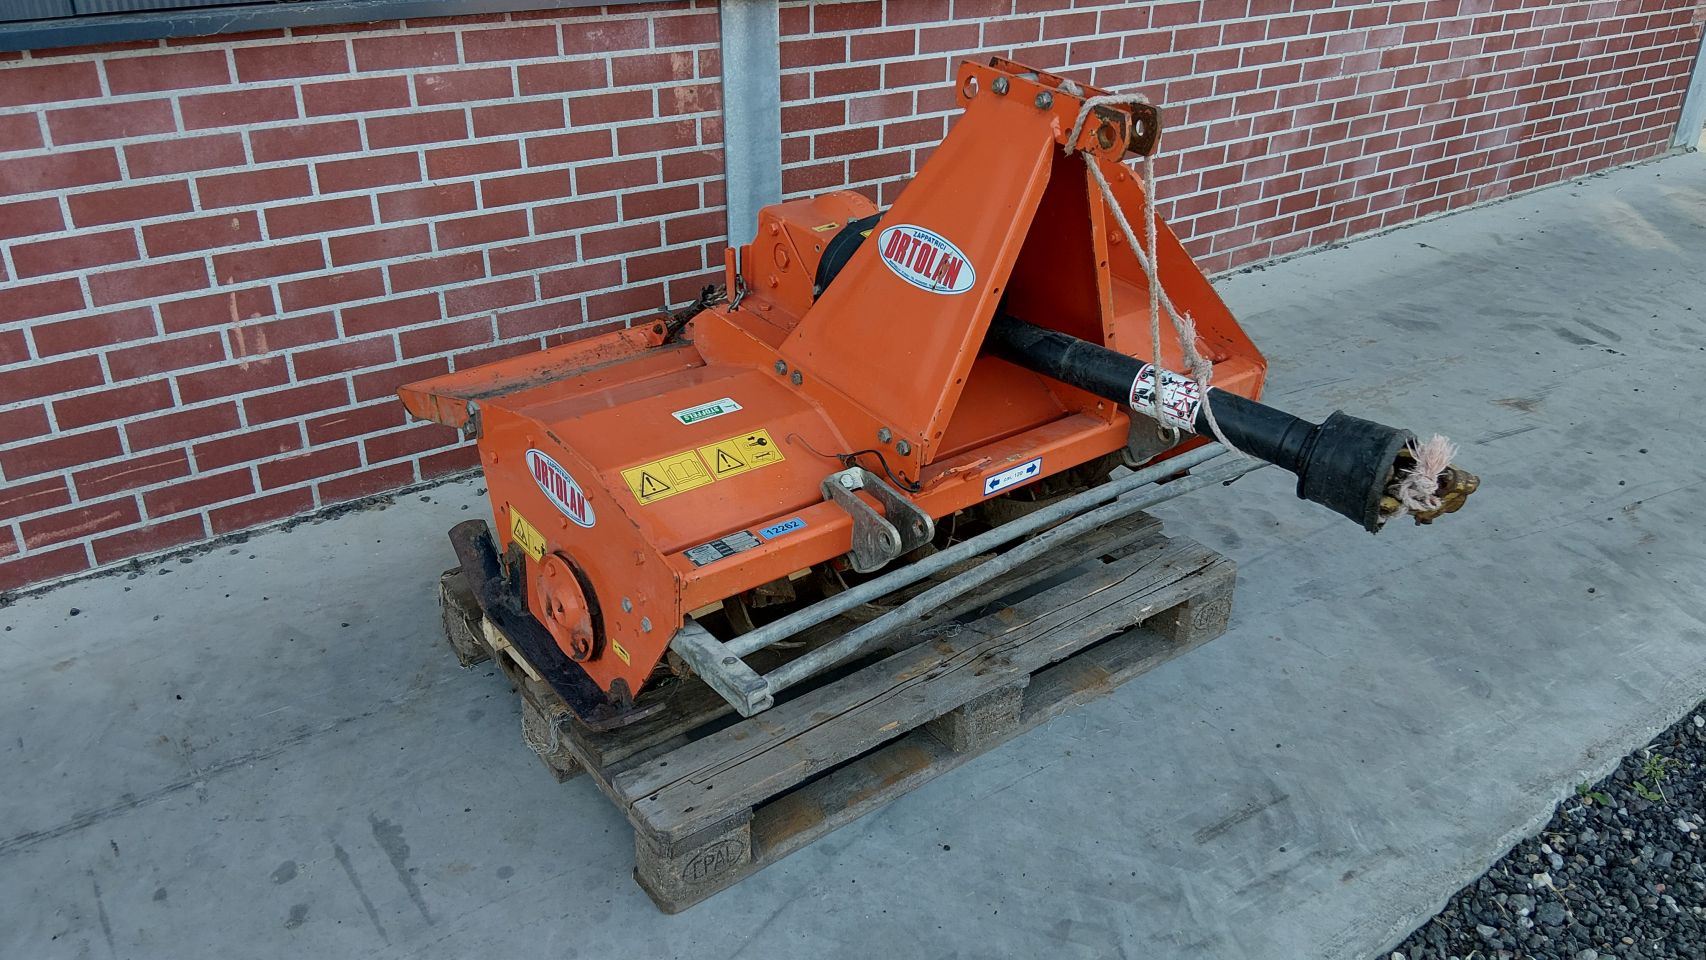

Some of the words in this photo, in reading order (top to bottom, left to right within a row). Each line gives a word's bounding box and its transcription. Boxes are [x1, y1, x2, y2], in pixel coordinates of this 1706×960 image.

[884, 229, 963, 289] ORTOLAN
[912, 231, 947, 251] ZAPPATRICI
[533, 452, 586, 523] ORTOLAN
[766, 520, 800, 536] 12262
